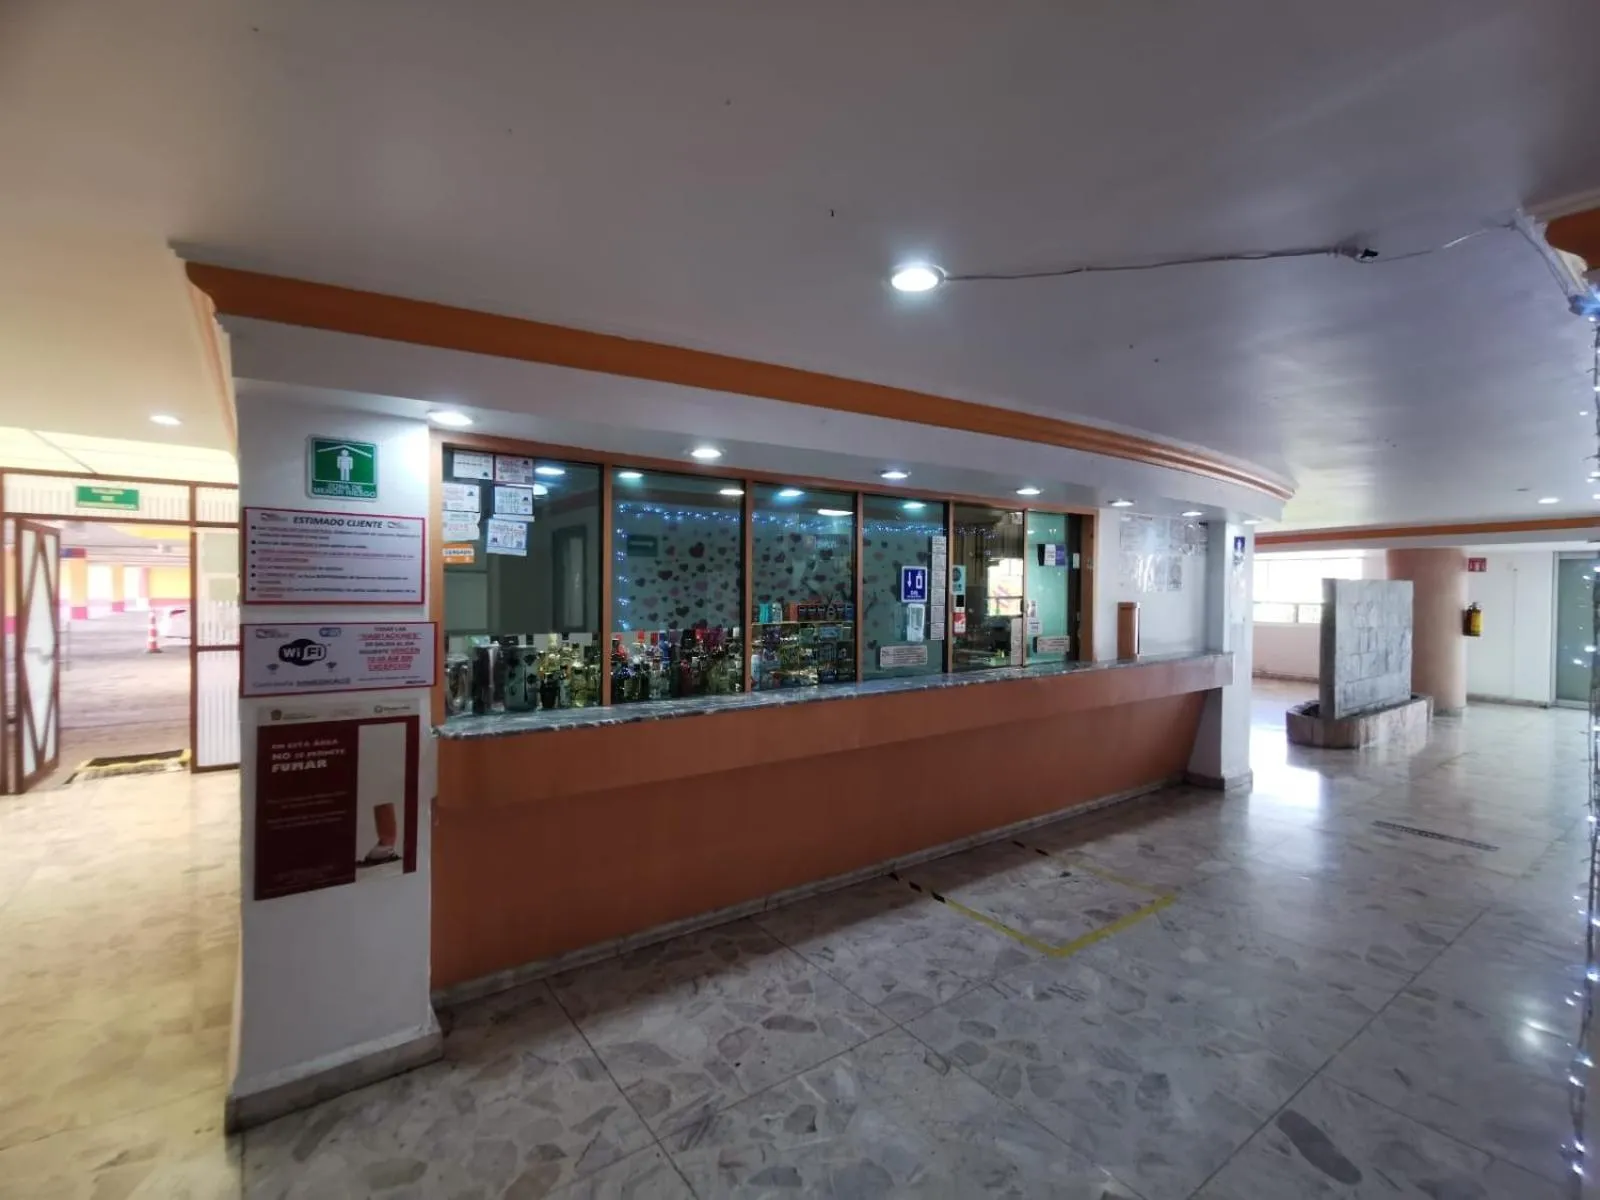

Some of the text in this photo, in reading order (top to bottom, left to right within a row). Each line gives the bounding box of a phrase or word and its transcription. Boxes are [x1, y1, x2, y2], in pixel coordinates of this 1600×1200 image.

[293, 516, 344, 526] ESTIMADO
[346, 519, 384, 529] CLIENTE
[272, 752, 291, 760] NO
[271, 760, 328, 772] FUMAR
